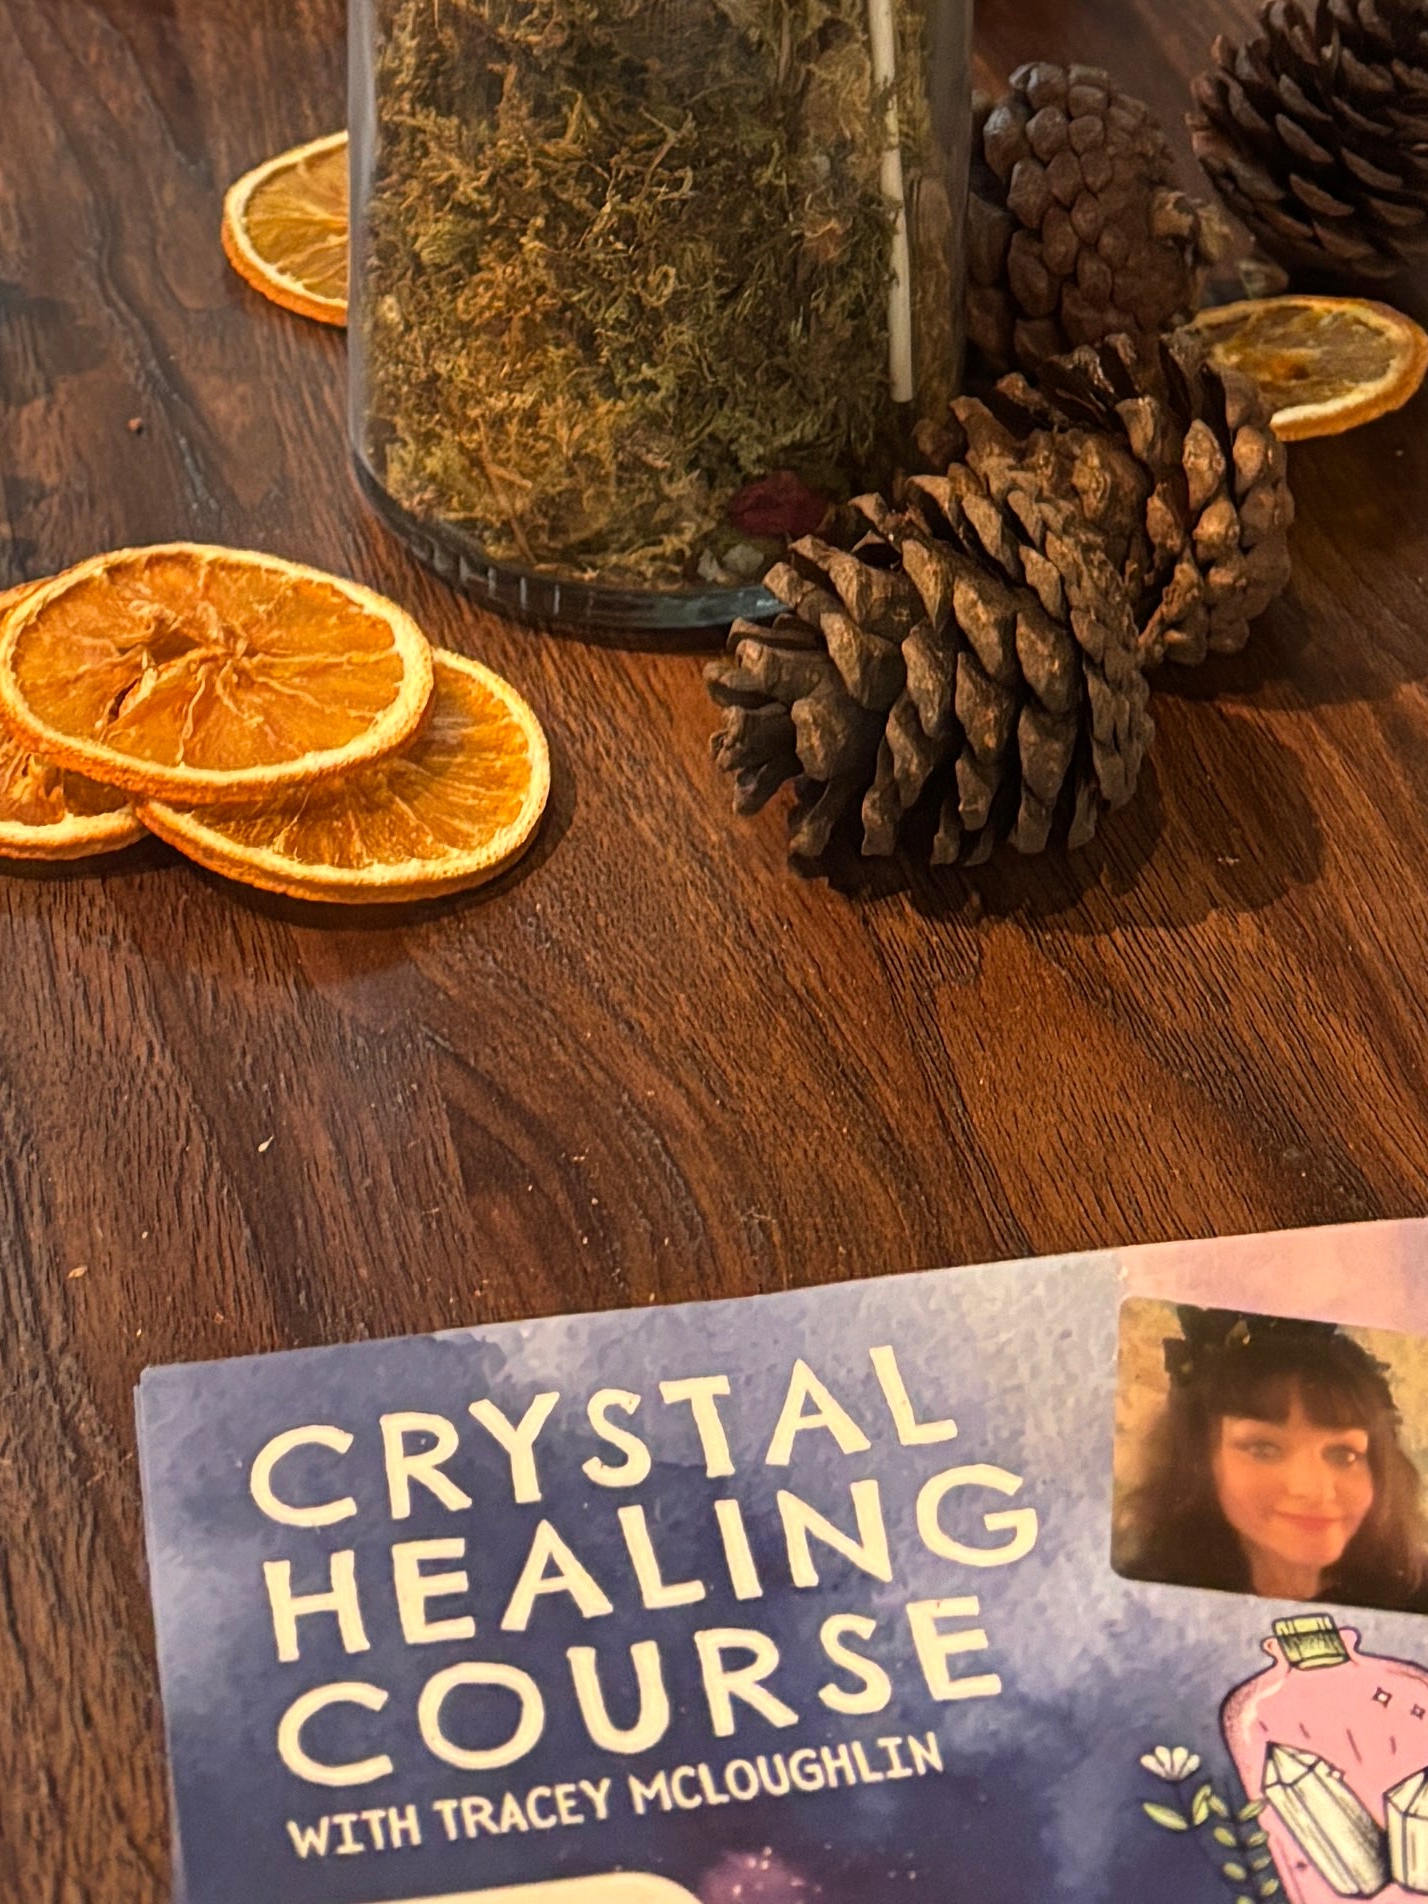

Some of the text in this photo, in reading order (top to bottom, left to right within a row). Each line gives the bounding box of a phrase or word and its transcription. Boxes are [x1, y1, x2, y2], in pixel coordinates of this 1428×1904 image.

[250, 1345, 958, 1529] CRYSTAL
[263, 1462, 1039, 1663] HEALING
[277, 1596, 1002, 1788] COURSE
[286, 1732, 944, 1859] WITH TRACEY MCLOUGHLIN
